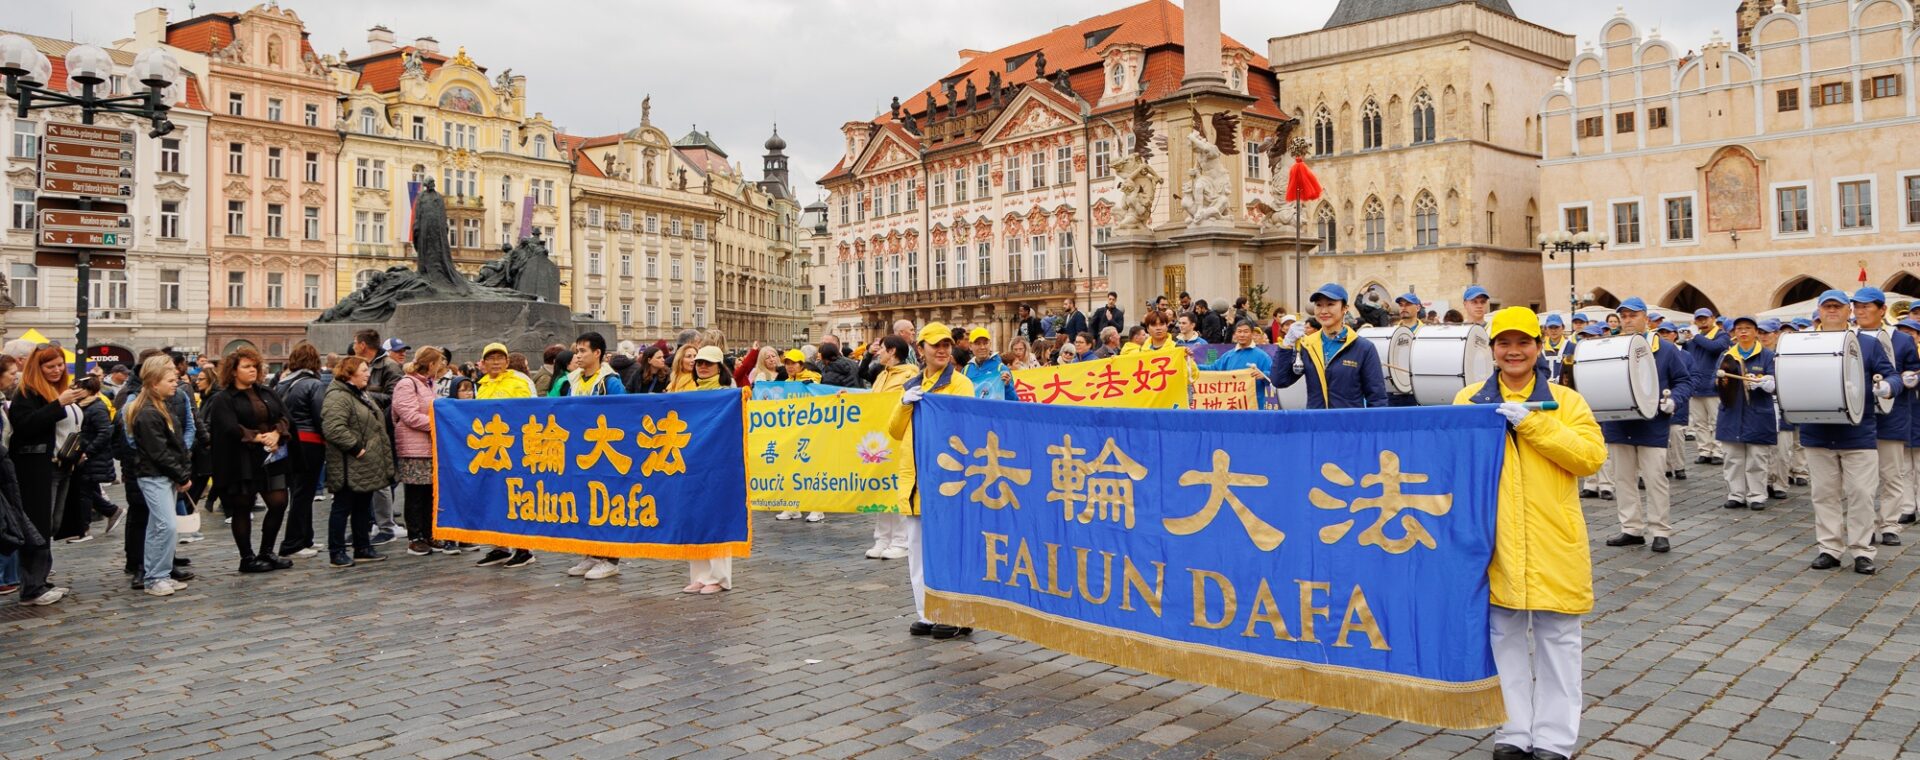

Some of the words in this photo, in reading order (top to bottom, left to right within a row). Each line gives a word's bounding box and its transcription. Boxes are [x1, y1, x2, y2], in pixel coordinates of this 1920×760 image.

[89, 234, 102, 243] Metro
[105, 234, 114, 244] A
[749, 399, 861, 433] potřebuje
[466, 410, 692, 478] 法輪大法
[505, 477, 579, 524] Falun
[587, 480, 659, 527] Dafa
[792, 472, 899, 491] Snášenlivost
[936, 430, 1453, 554] 法輪大法
[980, 531, 1167, 617] FALUN
[1185, 567, 1393, 651] DAFA
